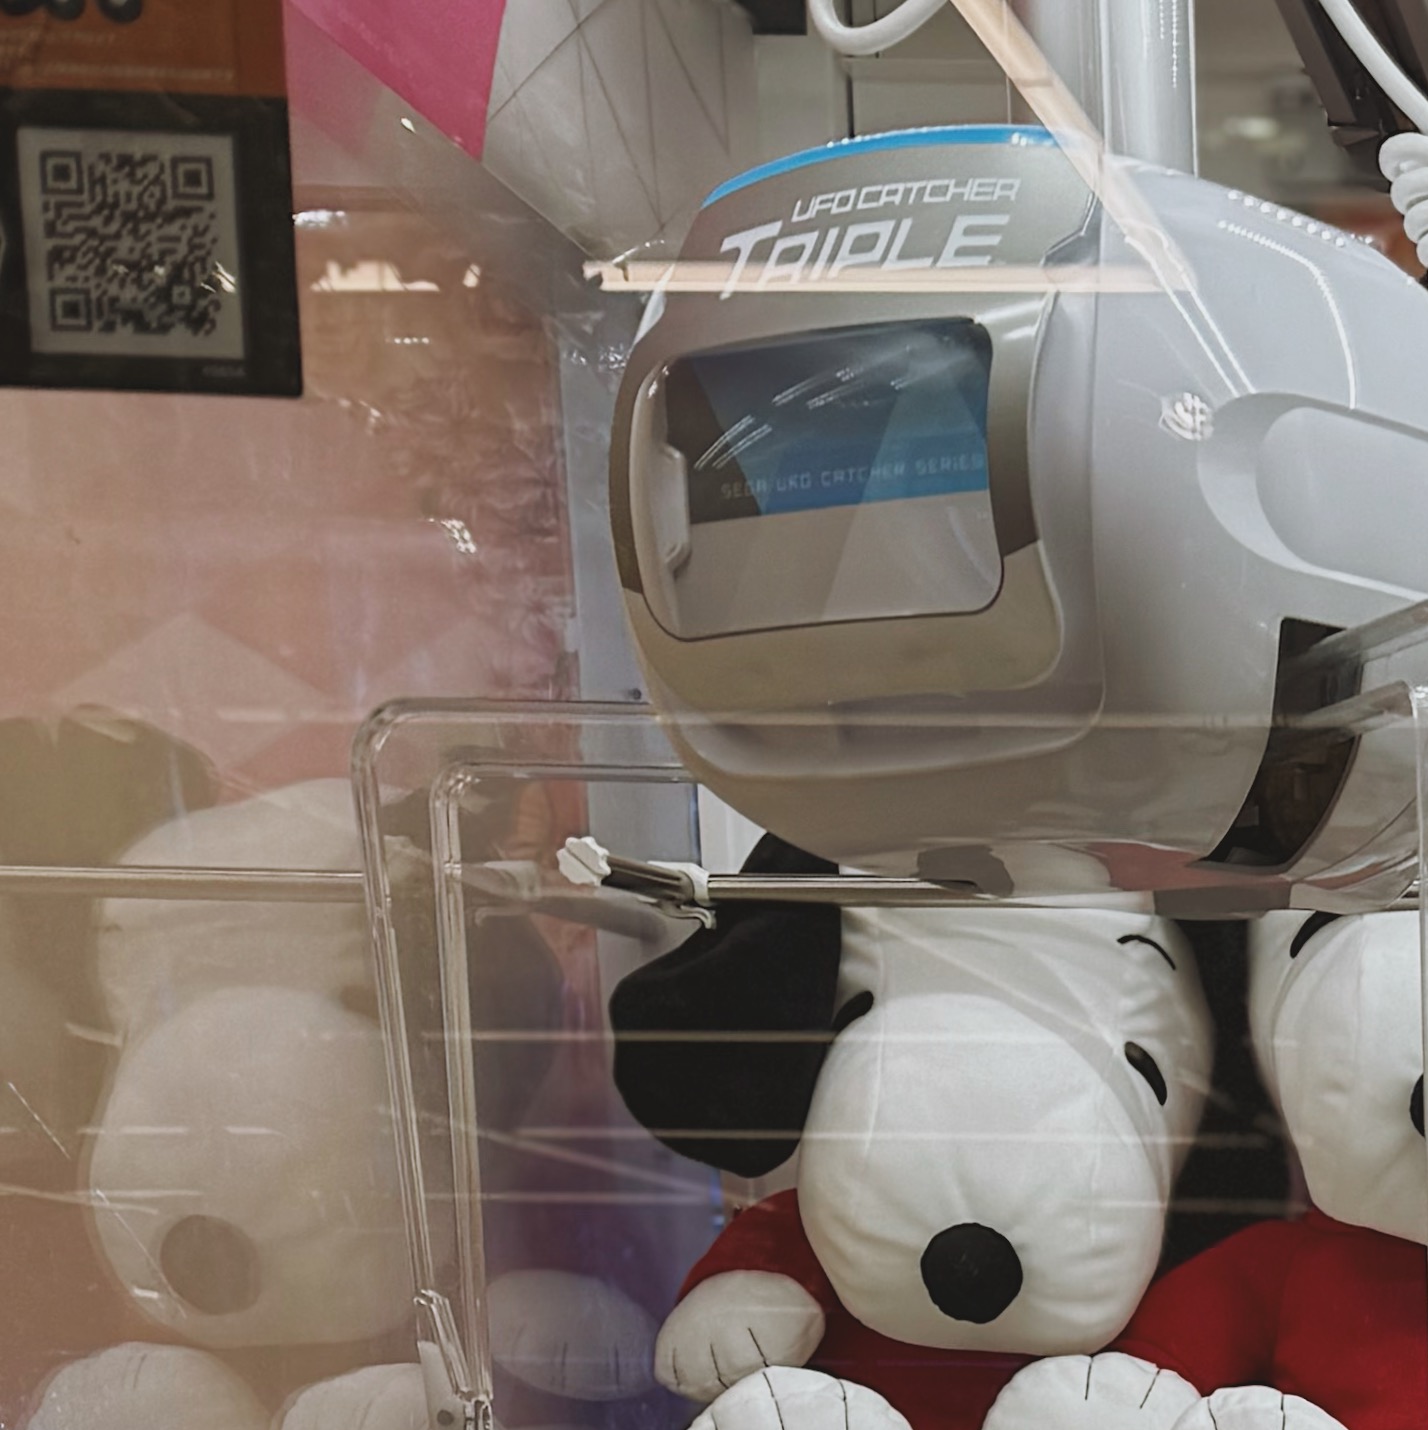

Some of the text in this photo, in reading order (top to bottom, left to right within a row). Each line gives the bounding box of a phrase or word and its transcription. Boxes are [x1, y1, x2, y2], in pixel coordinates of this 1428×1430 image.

[857, 177, 1021, 212] CATCHER
[719, 213, 1010, 301] TRIPLE
[821, 464, 905, 486] CATCHER
[916, 453, 984, 476] SERIES
